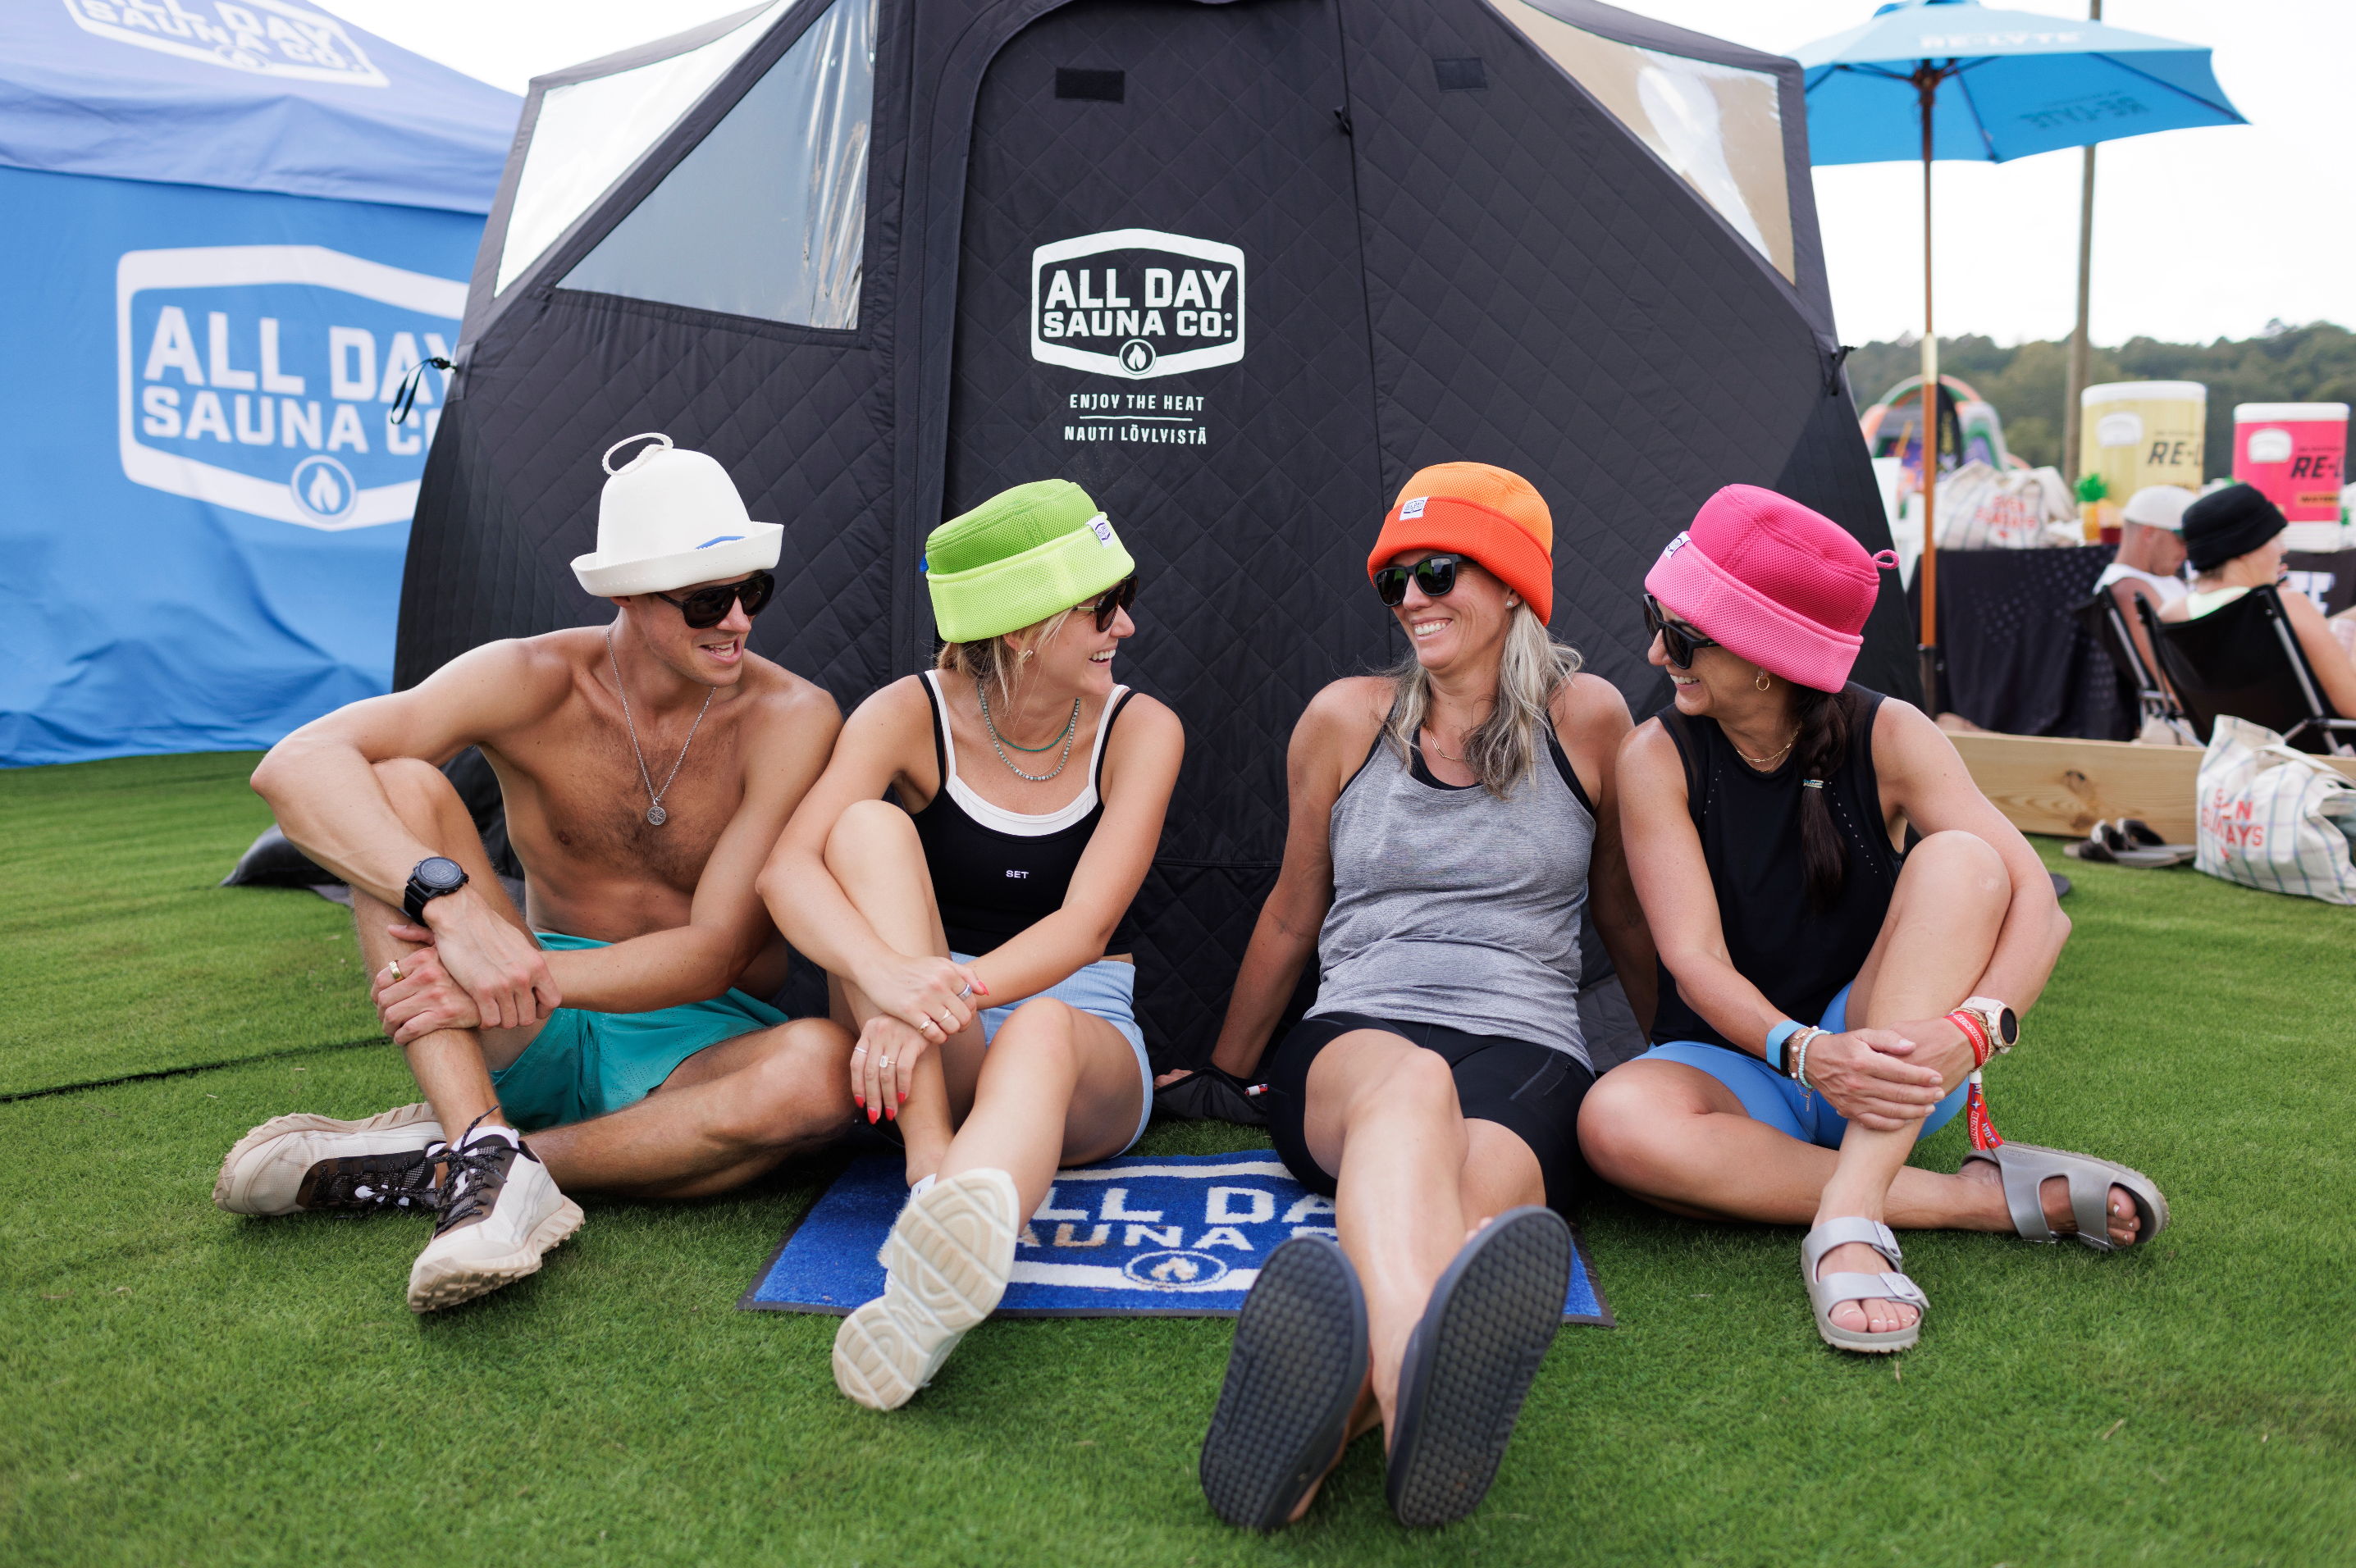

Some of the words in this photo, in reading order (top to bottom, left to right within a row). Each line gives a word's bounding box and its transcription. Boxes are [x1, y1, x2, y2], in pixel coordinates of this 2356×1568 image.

[86, 1, 272, 54] SAUNA
[212, 1, 333, 51] DAY
[1044, 268, 1131, 309] ALL
[1144, 267, 1233, 309] DAY
[1043, 309, 1167, 338] SAUNA
[143, 305, 305, 395] ALL
[142, 385, 369, 454] SAUNA
[1069, 394, 1121, 410] ENJOY
[1125, 394, 1157, 409] THE
[1163, 394, 1205, 412] HEAT
[1064, 426, 1114, 442] NAUTI
[1006, 870, 1030, 879] SET
[1030, 1187, 1163, 1222] LL
